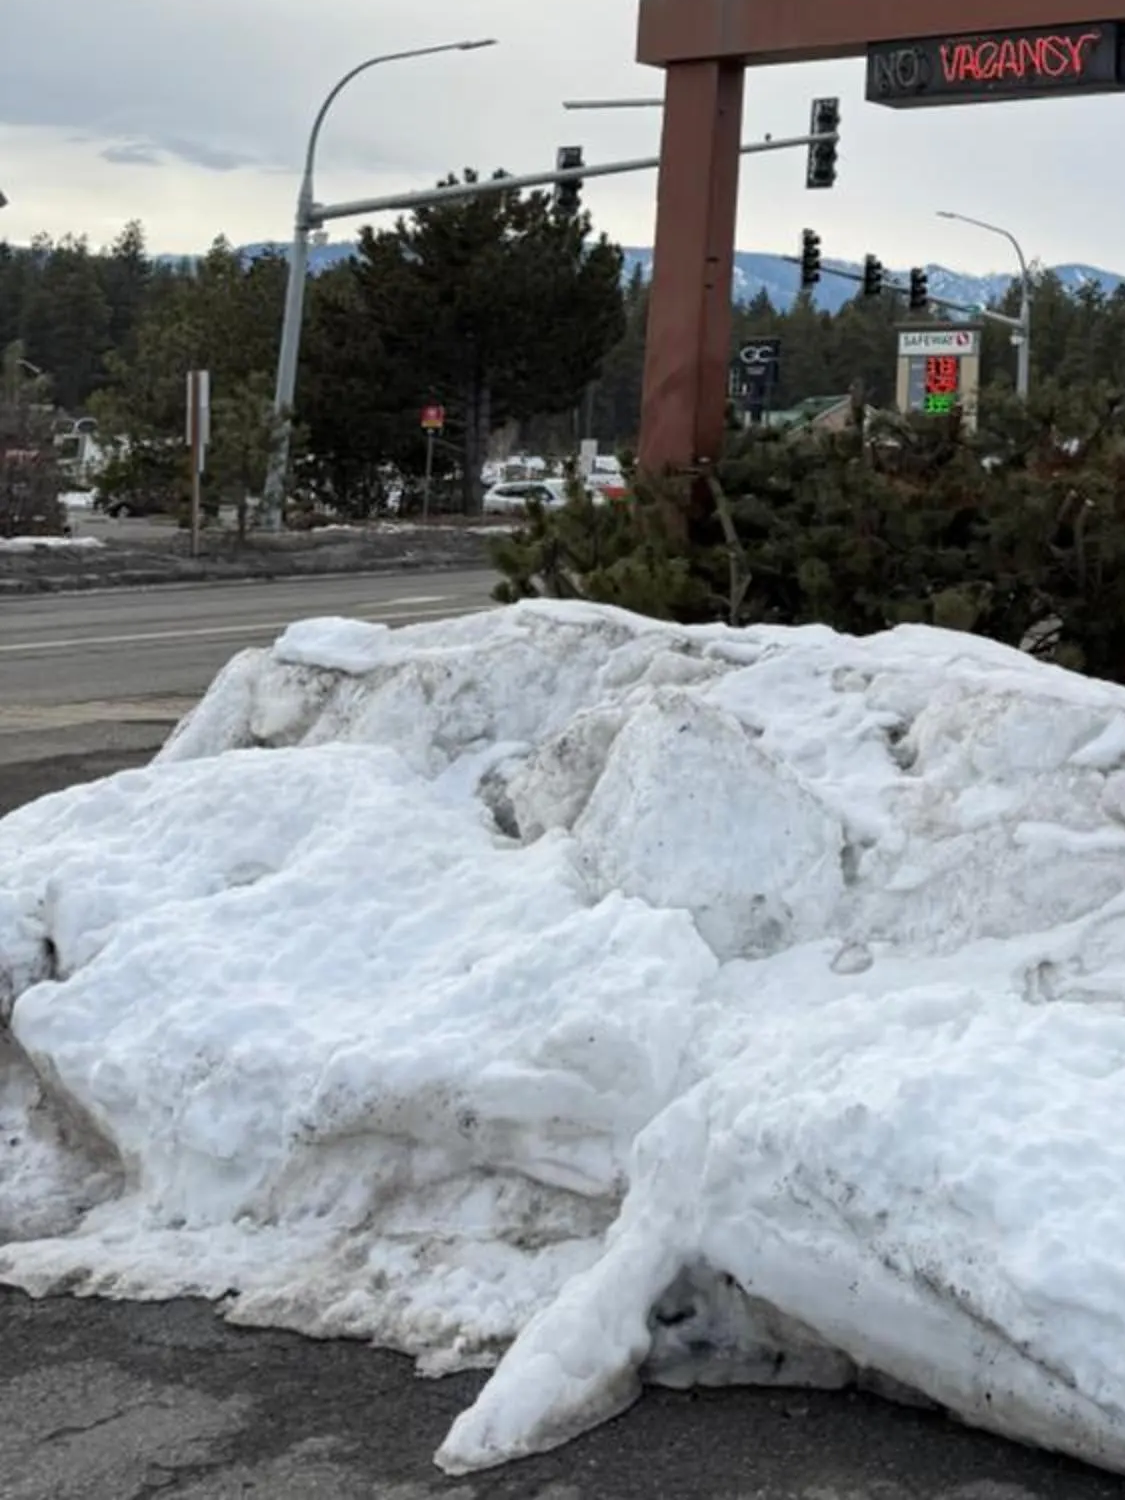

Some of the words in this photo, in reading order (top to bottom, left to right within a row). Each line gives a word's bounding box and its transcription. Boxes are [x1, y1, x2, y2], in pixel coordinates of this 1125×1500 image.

[874, 47, 919, 89] NO
[939, 33, 1100, 84] VACANCY
[903, 332, 954, 347] SAFEWAY
